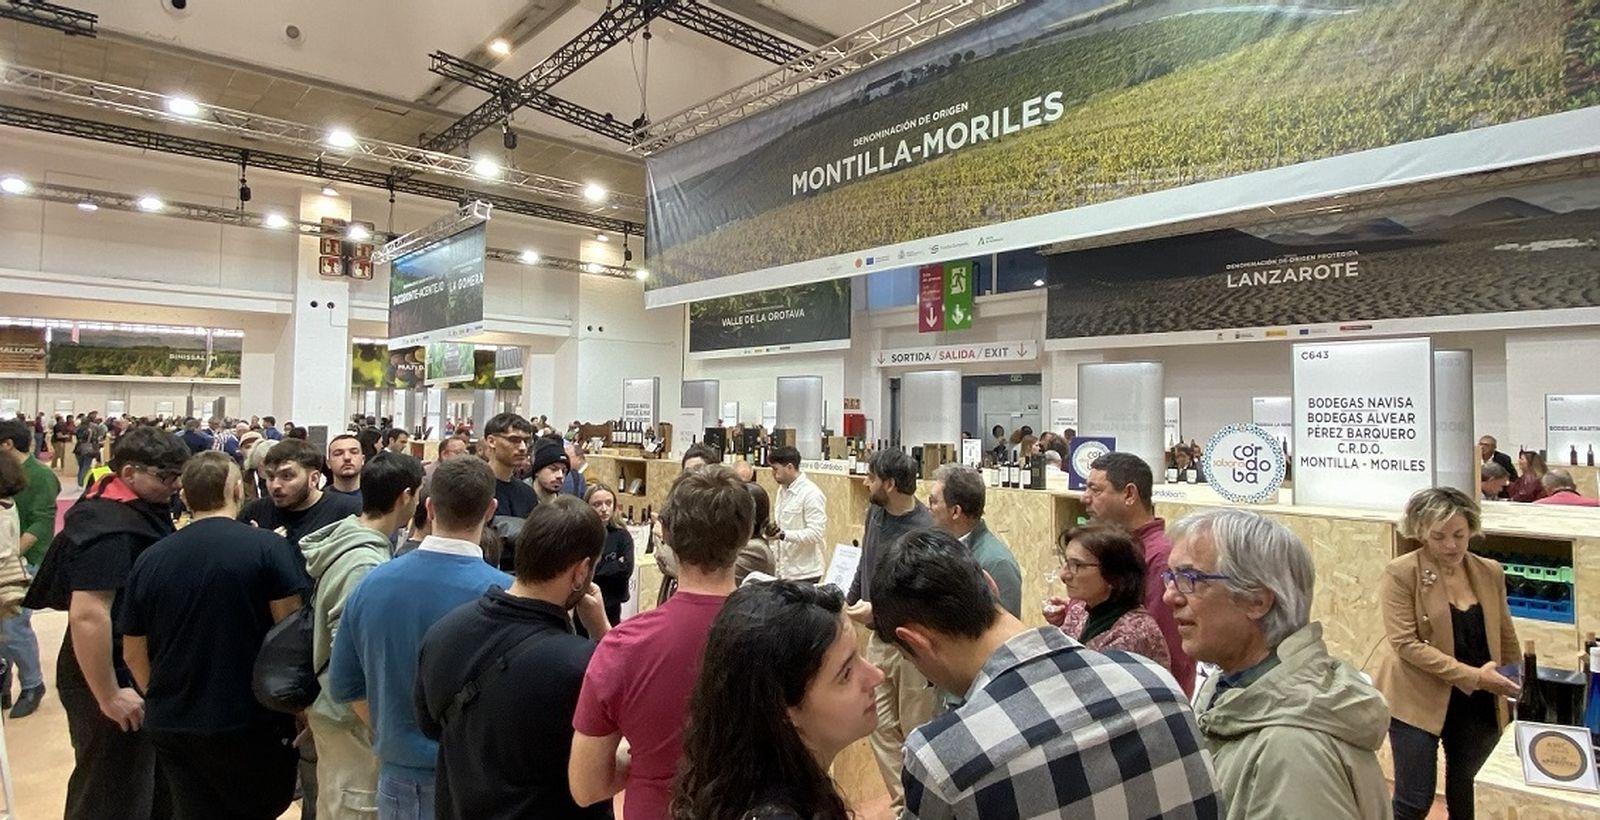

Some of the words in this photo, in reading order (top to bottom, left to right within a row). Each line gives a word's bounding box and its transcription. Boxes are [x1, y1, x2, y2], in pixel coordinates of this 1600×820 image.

[853, 119, 917, 147] DENOMINACIÓN
[918, 114, 931, 126] DE
[932, 101, 969, 121] ORIGEN
[791, 91, 1065, 196] MONTILLA-MORILES
[1289, 254, 1316, 263] ORIGEN
[1317, 250, 1359, 260] PROTEGIDA
[1227, 261, 1359, 288] LANZAROTE
[721, 316, 743, 327] VALLE
[744, 314, 755, 324] DE
[756, 313, 767, 323] LA
[768, 308, 805, 321] OROTAVA
[891, 352, 931, 363] SORTIDA
[939, 348, 976, 361] SALIDA
[984, 347, 1009, 358] EXIT
[1300, 350, 1329, 361] C643
[1308, 397, 1364, 409] BODEGAS
[1367, 396, 1414, 409] NAVISA
[1307, 412, 1363, 424] BODEGAS
[1366, 412, 1416, 424] ALVEAR
[1307, 424, 1343, 439] PÉREZ
[1347, 427, 1417, 440] BARQUERO
[1337, 442, 1383, 455] C.R.D.O.
[1300, 456, 1359, 469] MONTILLA
[1370, 459, 1426, 472] MORILES
